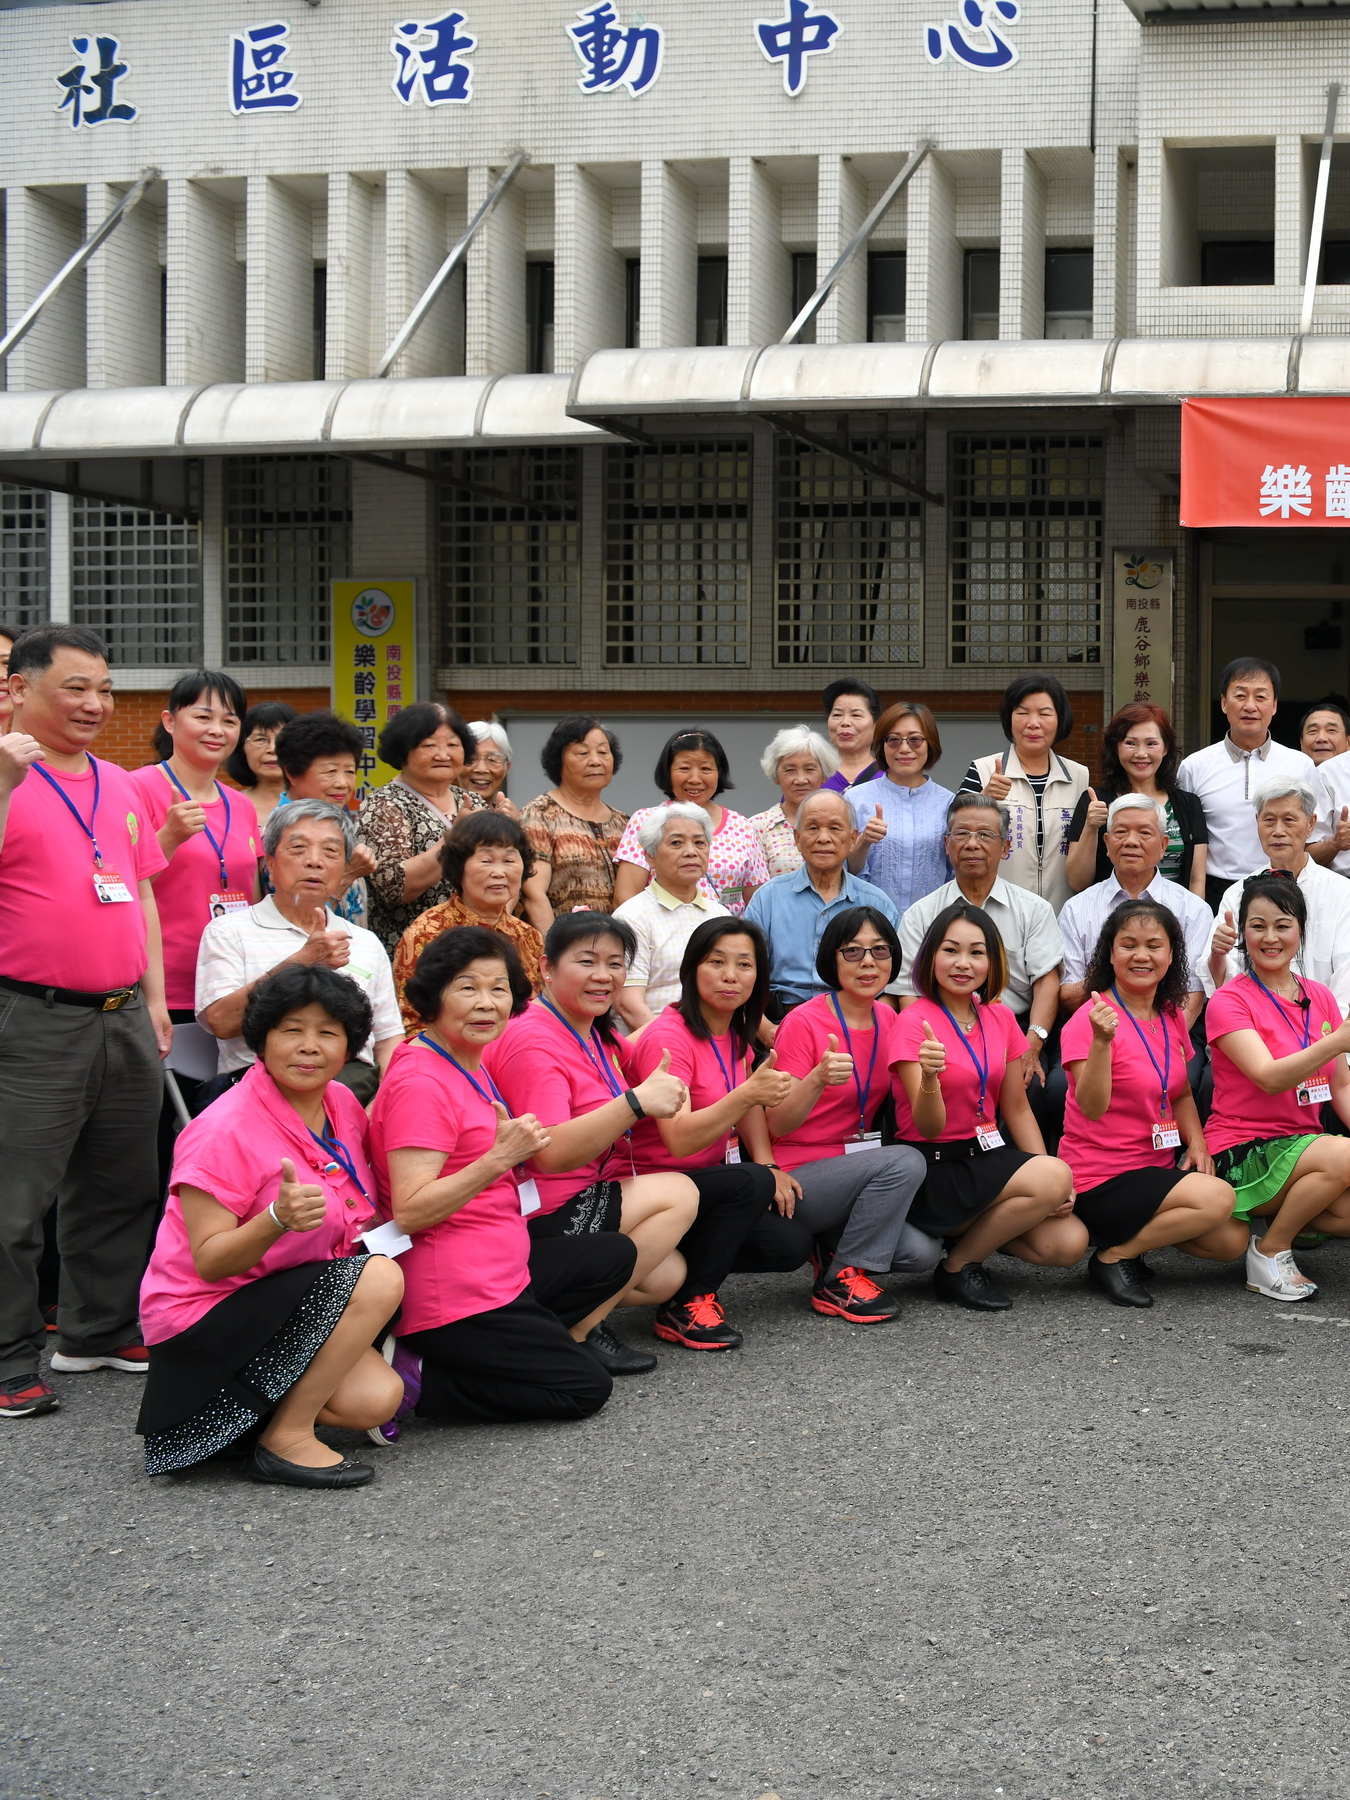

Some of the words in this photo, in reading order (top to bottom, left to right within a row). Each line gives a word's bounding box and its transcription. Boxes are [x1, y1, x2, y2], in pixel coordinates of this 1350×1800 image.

[57, 0, 1020, 128] 社區活動中心
[1126, 598, 1161, 610] 南投縣
[1016, 807, 1024, 849] 南投縣議員
